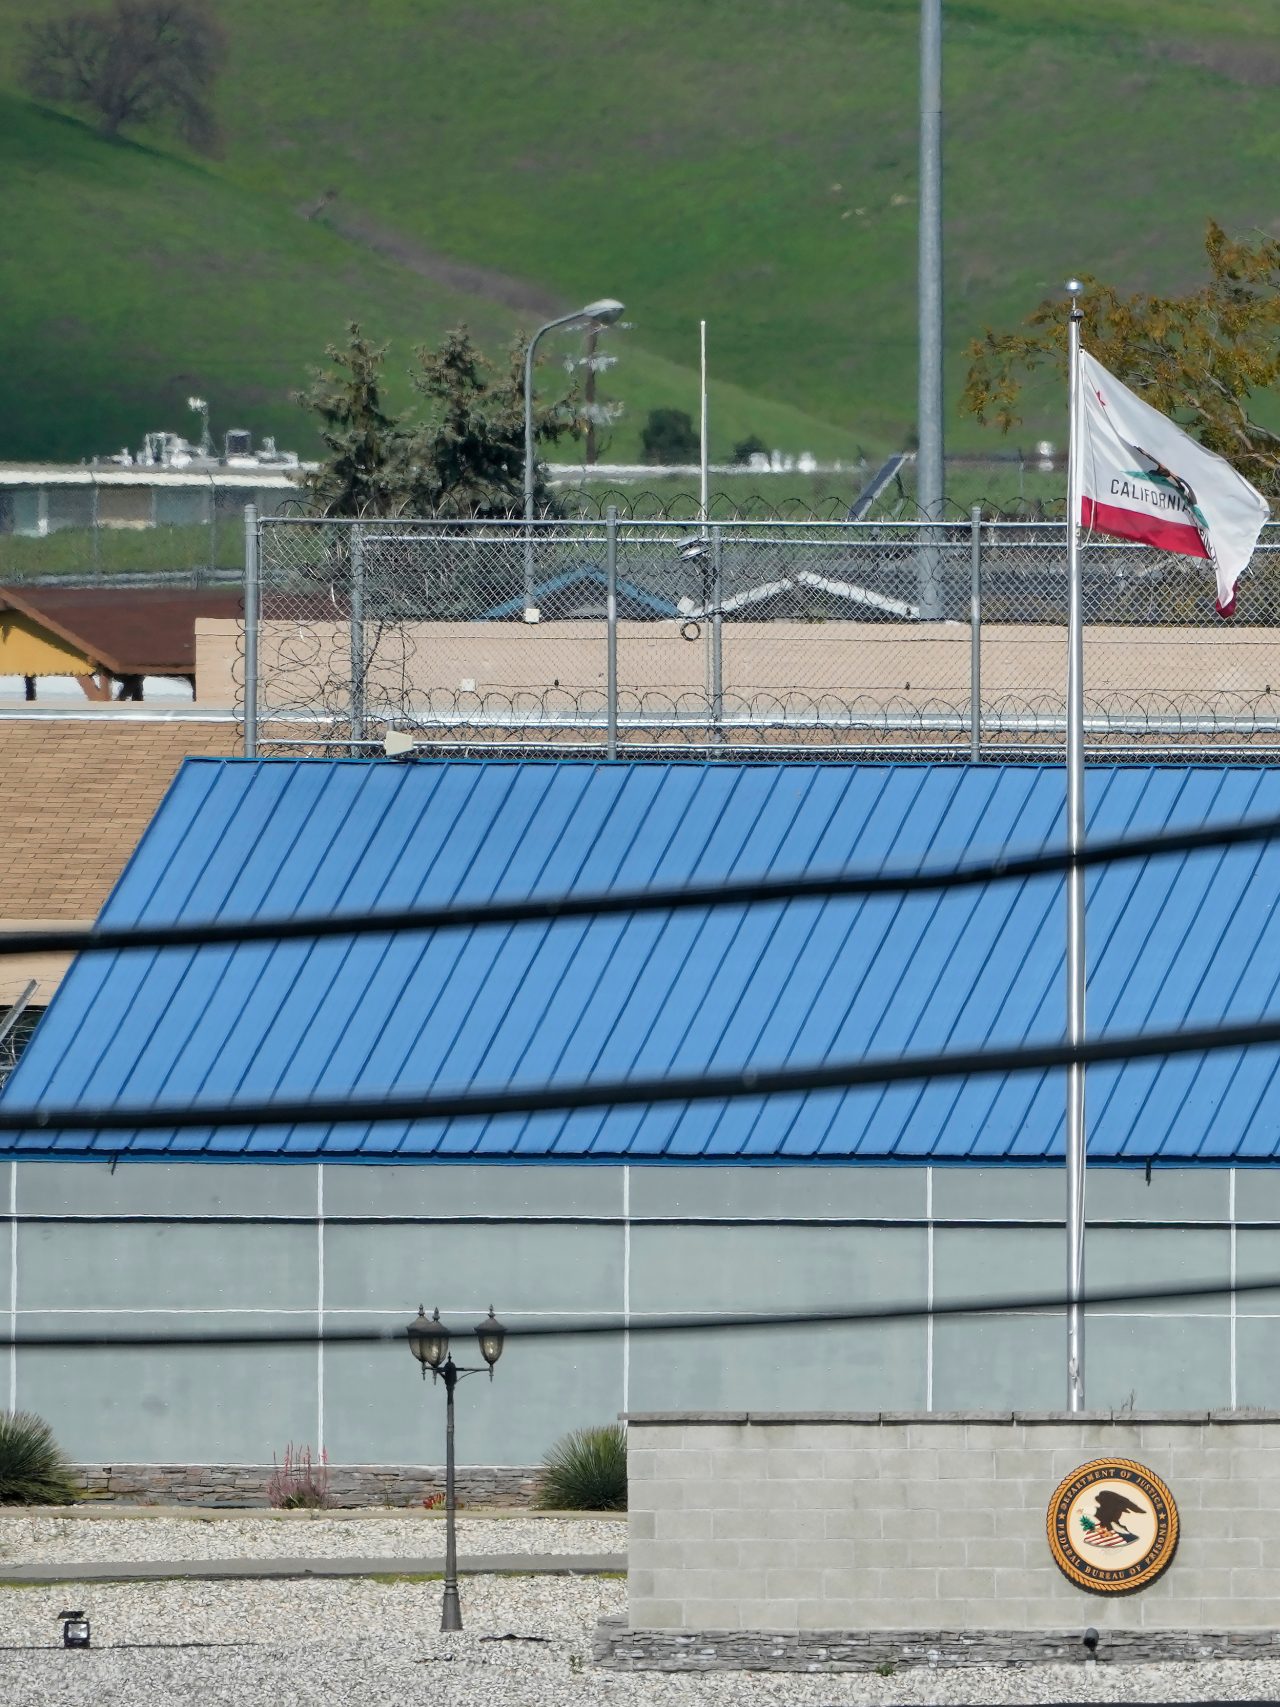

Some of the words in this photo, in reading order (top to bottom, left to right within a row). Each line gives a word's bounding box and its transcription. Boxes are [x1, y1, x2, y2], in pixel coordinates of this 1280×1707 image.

[1110, 479, 1191, 515] CALIFORNIA
[1062, 1469, 1115, 1510] DEPARTMENT
[1120, 1470, 1132, 1479] OF
[1136, 1477, 1163, 1509] JUSTICE
[1057, 1523, 1080, 1566] FEDERAL
[1085, 1566, 1124, 1580] BUREAU
[1130, 1566, 1141, 1575] OF
[1145, 1523, 1167, 1565] PRISONS
